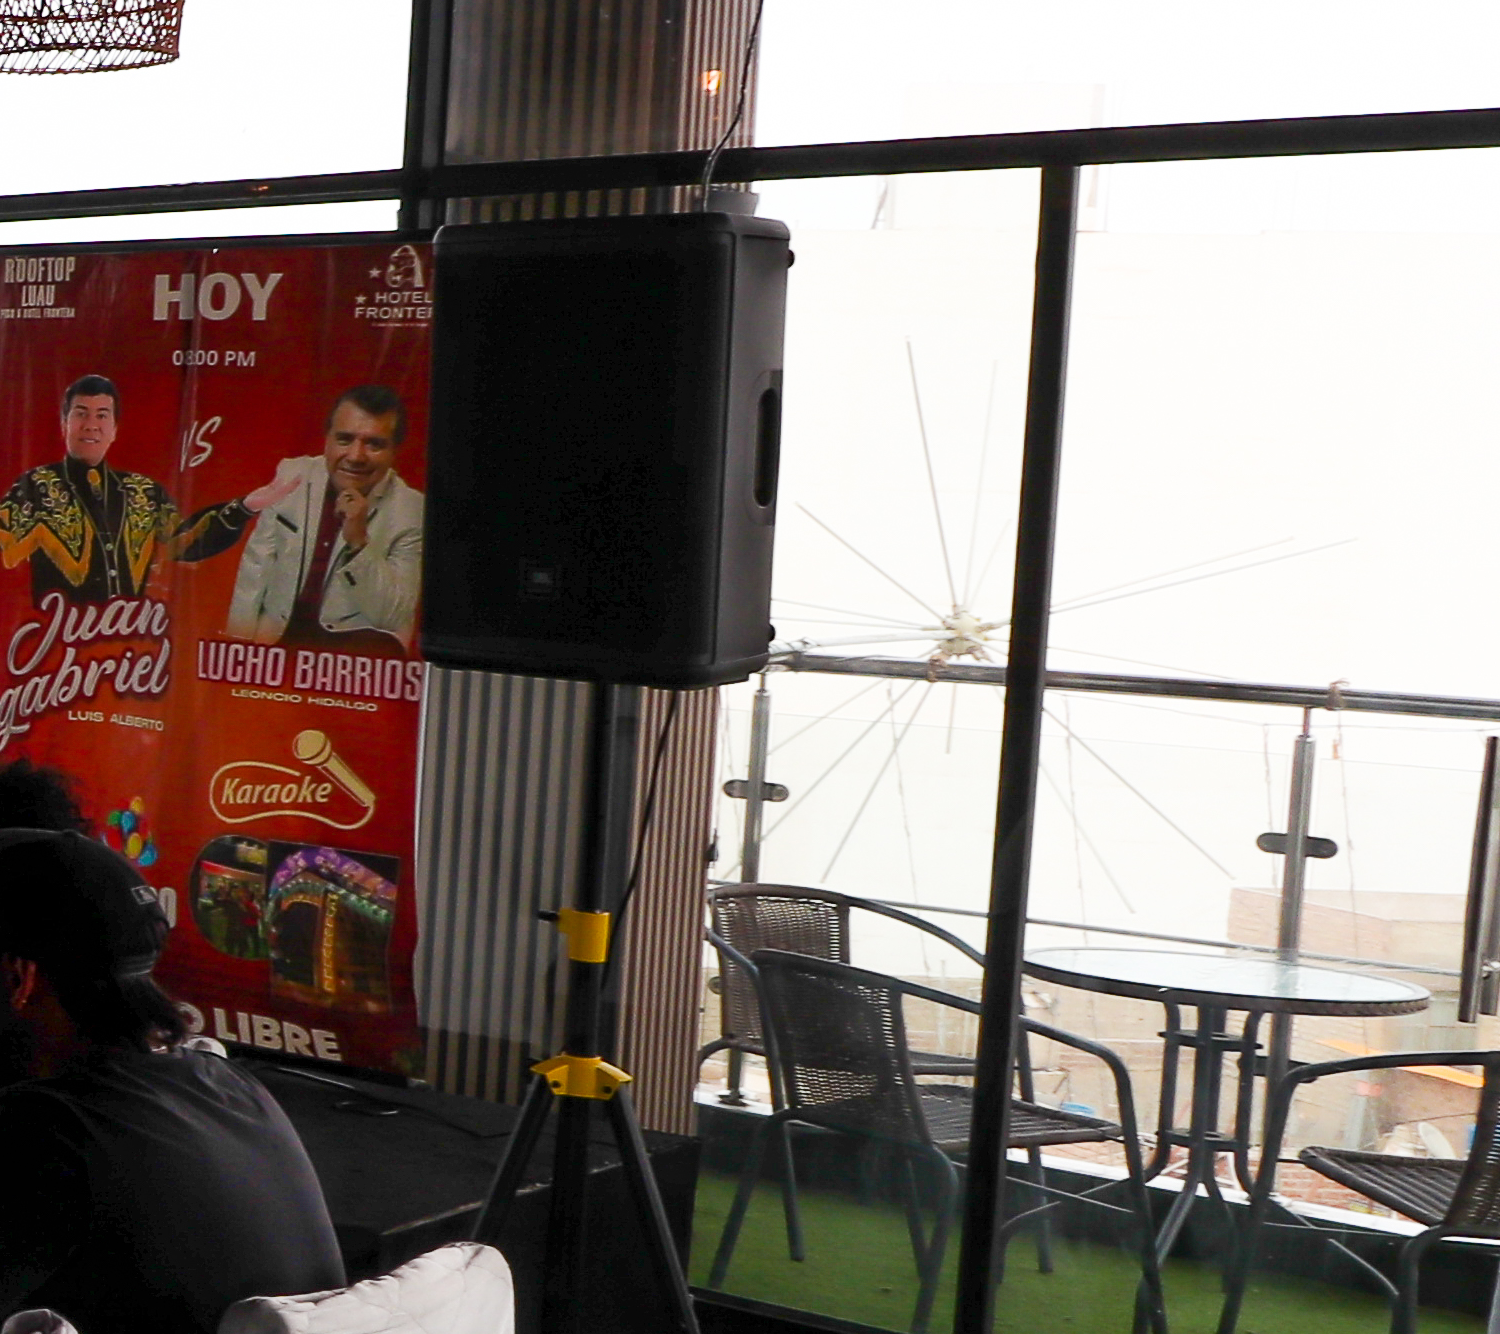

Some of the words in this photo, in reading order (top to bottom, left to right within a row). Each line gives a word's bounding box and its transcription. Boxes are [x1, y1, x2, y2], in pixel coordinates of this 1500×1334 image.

[4, 256, 76, 283] ROOFTOP
[21, 284, 56, 307] LUAU
[152, 272, 284, 322] HOY
[375, 291, 433, 304] HOTEL
[224, 350, 257, 367] PM
[10, 592, 168, 676] Juan
[197, 641, 286, 688] LUCHO
[294, 650, 424, 702] BARRIOS
[231, 688, 302, 704] LEONCIO
[307, 697, 379, 713] HIDALGO
[68, 710, 104, 723] LUIS
[110, 714, 165, 731] ALBERTO
[221, 776, 333, 805] Karaoke
[212, 1007, 343, 1062] LIBRE
